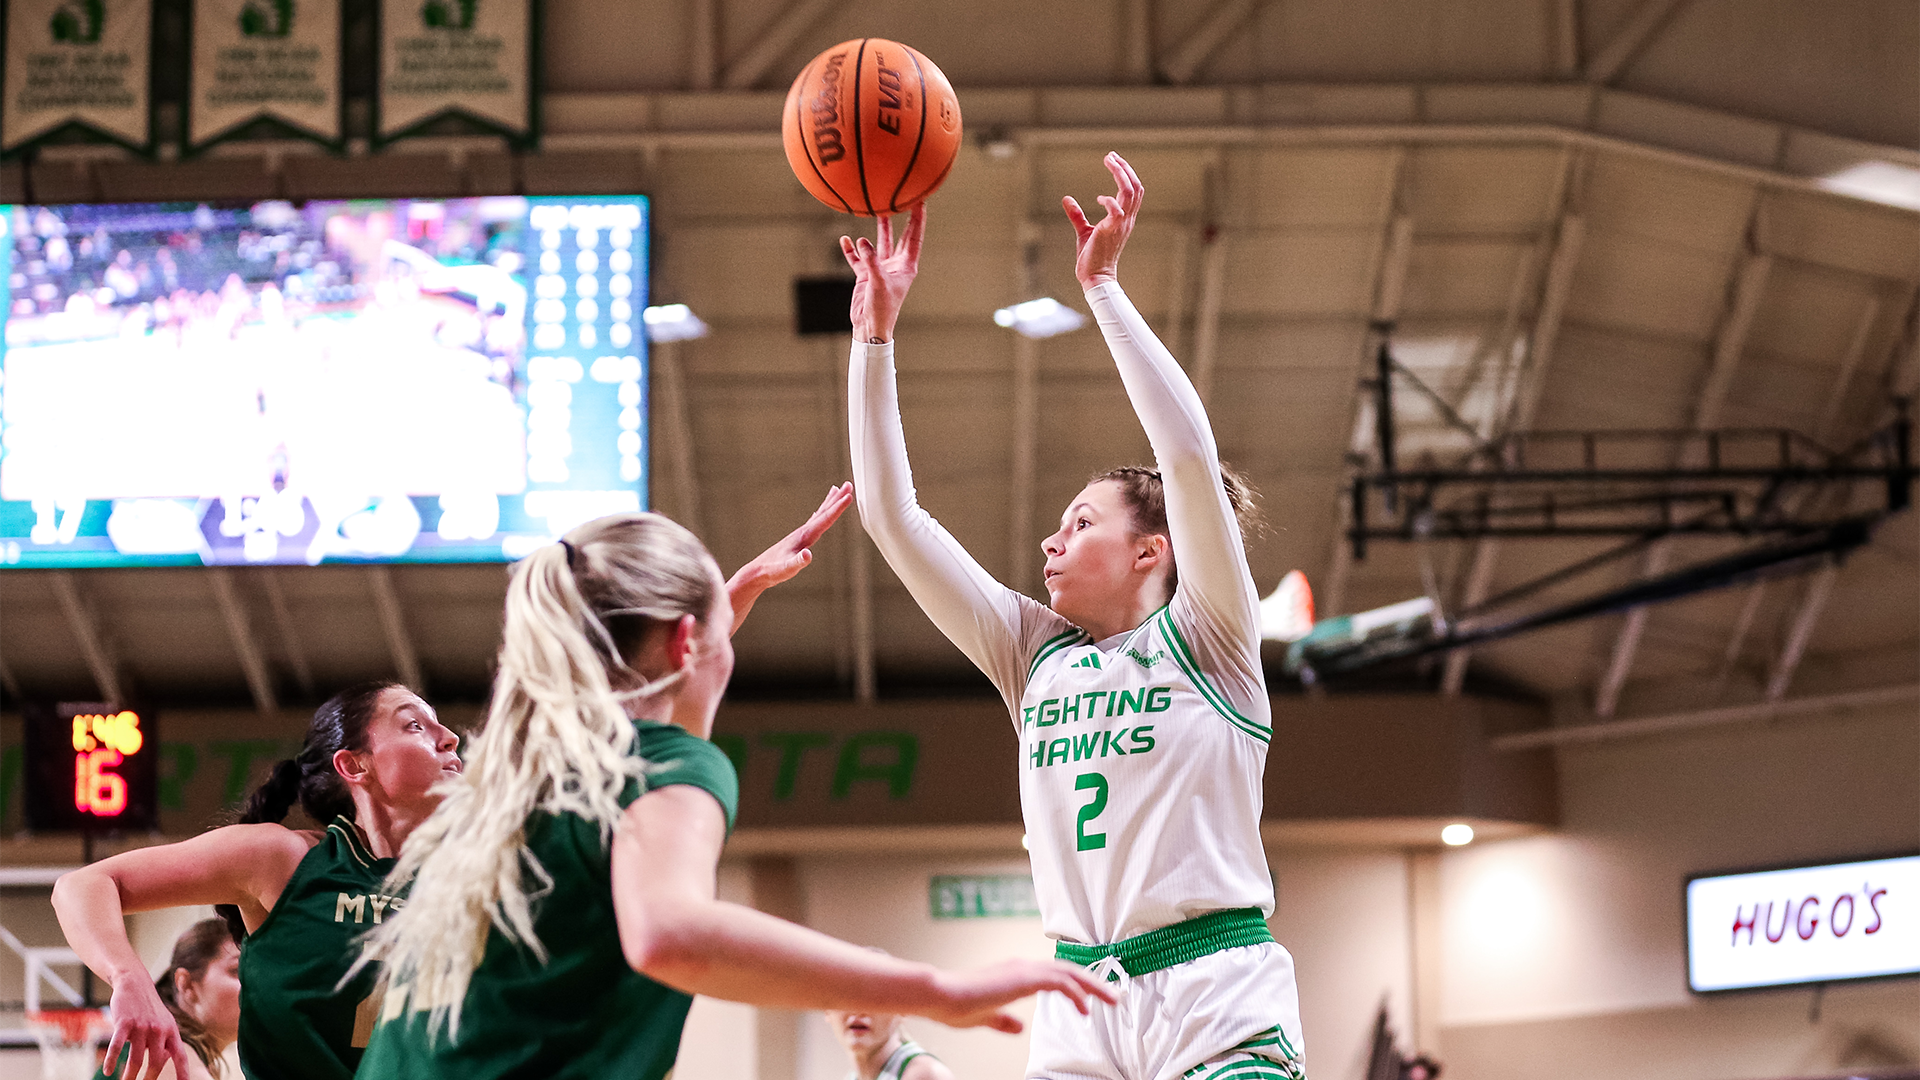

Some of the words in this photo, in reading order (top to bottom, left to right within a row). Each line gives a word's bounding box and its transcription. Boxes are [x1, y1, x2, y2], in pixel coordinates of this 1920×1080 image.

[811, 50, 848, 167] Wilson
[878, 67, 901, 137] EVO
[1029, 725, 1156, 770] HAWKS
[75, 748, 128, 817] 16
[1074, 772, 1109, 852] 2
[1731, 881, 1888, 948] HUGO'S
